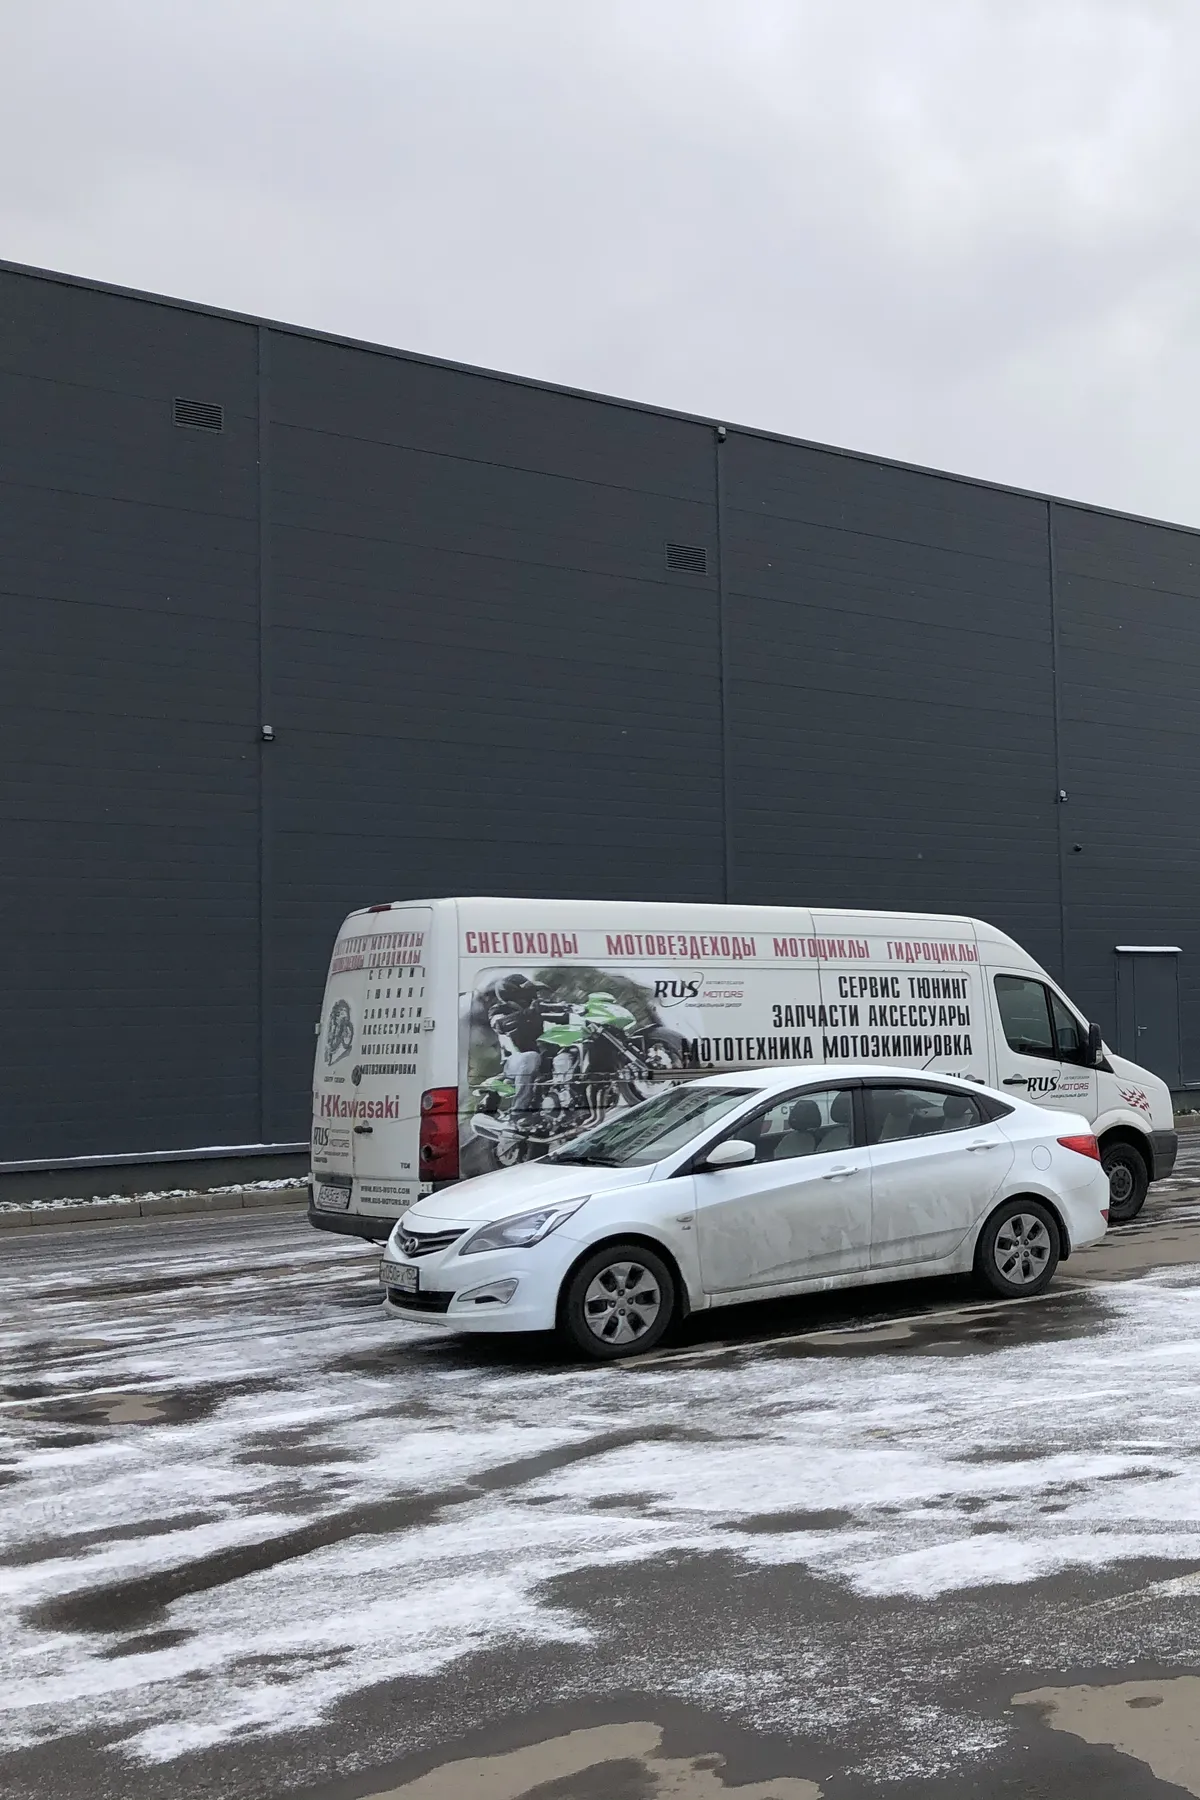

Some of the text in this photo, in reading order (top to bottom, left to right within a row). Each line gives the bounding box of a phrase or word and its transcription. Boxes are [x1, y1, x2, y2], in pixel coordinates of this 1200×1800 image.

[465, 932, 979, 964] СНЕГОХОДЫ МОТОВЕЗДЕХОДЫ МОТОЦИКЛЫ ГИДРОЦИКЛЫ
[654, 979, 700, 998] RUS
[838, 976, 968, 999] СЕРВИС ТЮНИНГ
[772, 1005, 971, 1028] ЗАПЧАСТИ АКСЕССУАРЫ
[363, 1023, 420, 1035] АКСЕССУАРЫ
[361, 1044, 418, 1055] МОТОТЕХНИКА
[681, 1034, 973, 1063] МОТОТЕХНИКА МОТОЭКИПИРОВКА
[1027, 1077, 1057, 1091] RUS
[332, 1095, 399, 1118] Kawasaki
